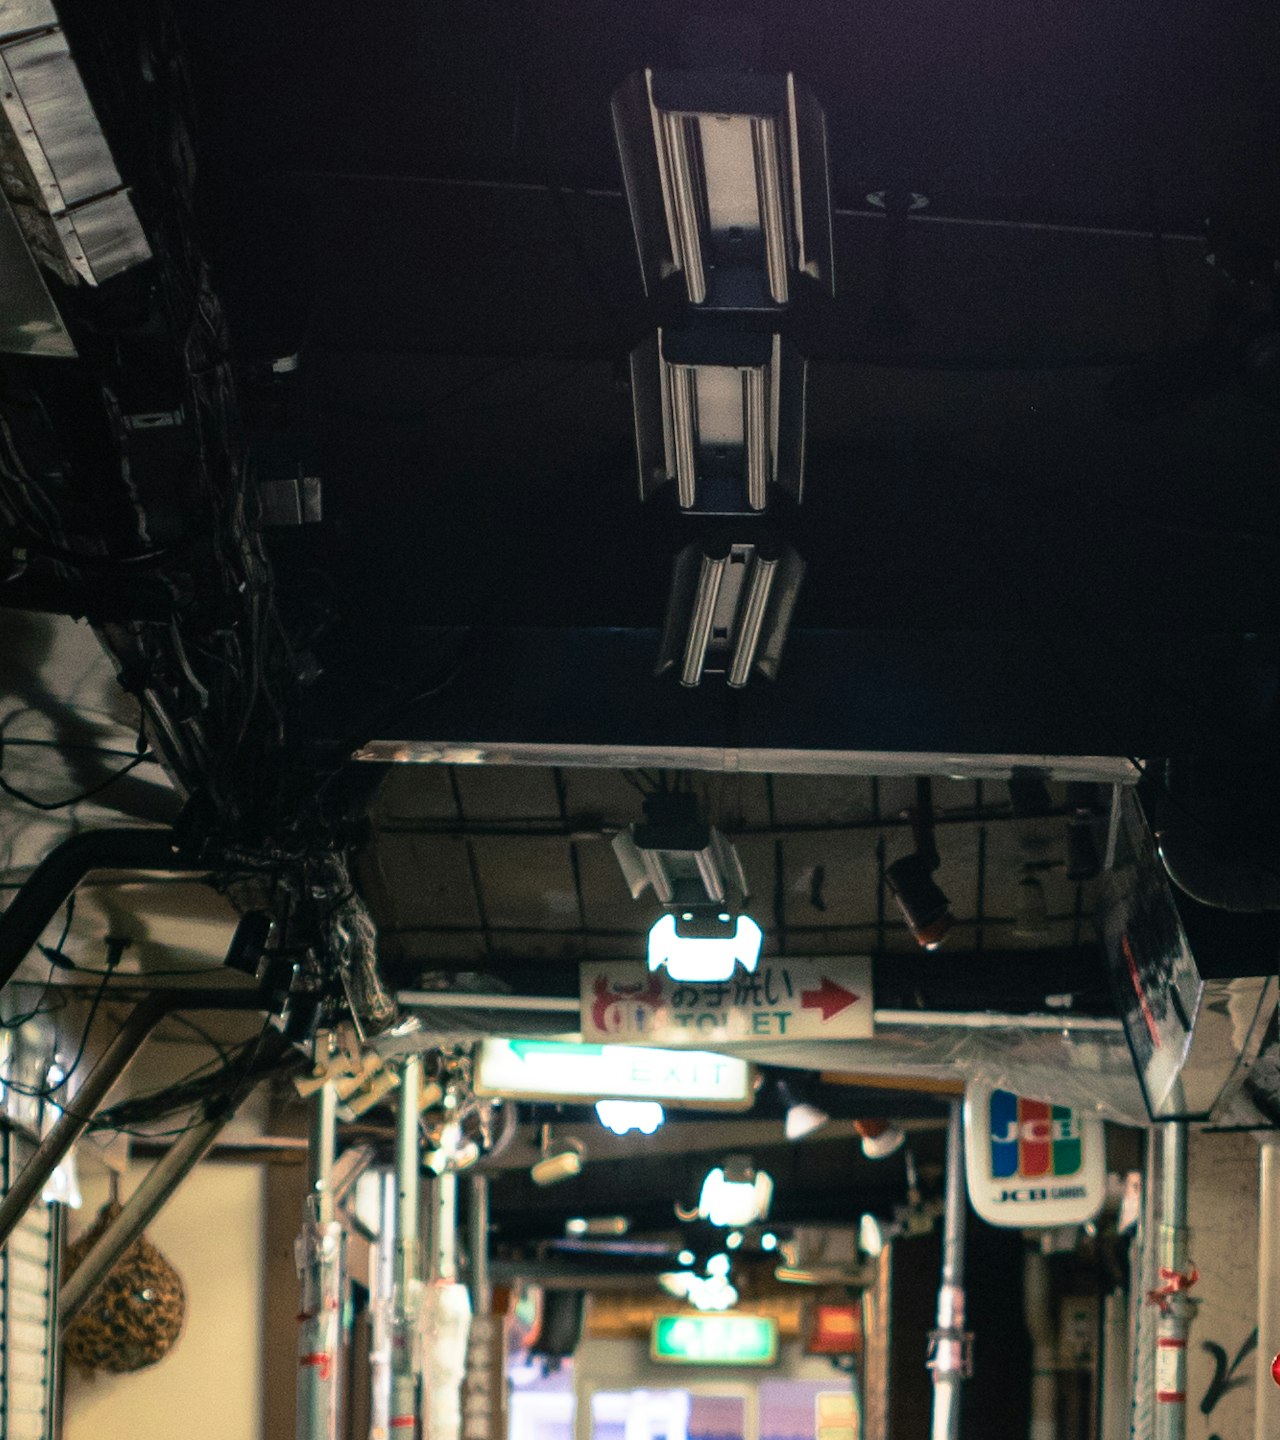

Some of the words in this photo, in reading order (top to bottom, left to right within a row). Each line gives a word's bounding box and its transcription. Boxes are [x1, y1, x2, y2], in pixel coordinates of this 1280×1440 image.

[674, 1011, 792, 1035] TOIET
[631, 1059, 728, 1085] EXIT
[991, 1119, 1082, 1143] JCB
[992, 1188, 1047, 1203] JCB
